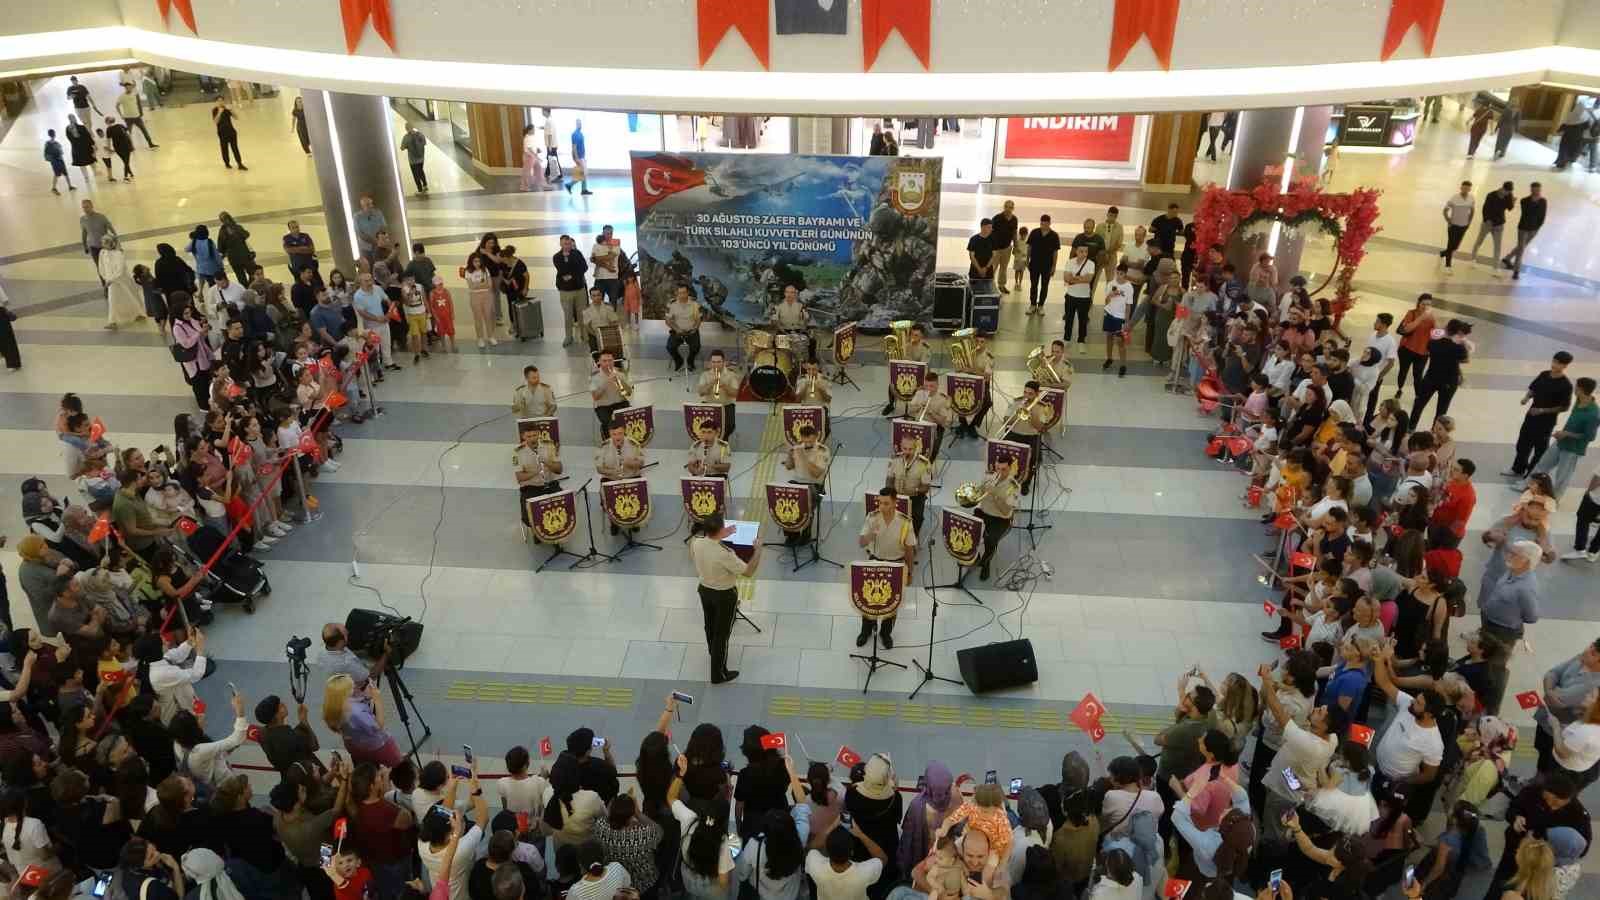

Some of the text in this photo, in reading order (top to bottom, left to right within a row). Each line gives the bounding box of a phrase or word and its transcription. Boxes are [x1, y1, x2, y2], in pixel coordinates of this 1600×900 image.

[696, 212, 861, 227] 30 AĞUSTOS ZAFER BAYRAMI VE
[684, 224, 873, 240] TÜRK SİLAHLI KUVVETLERİ GÜNÜNÜN
[721, 238, 836, 252] 103'ÜNCÜ YIL DÖNÜMÜ
